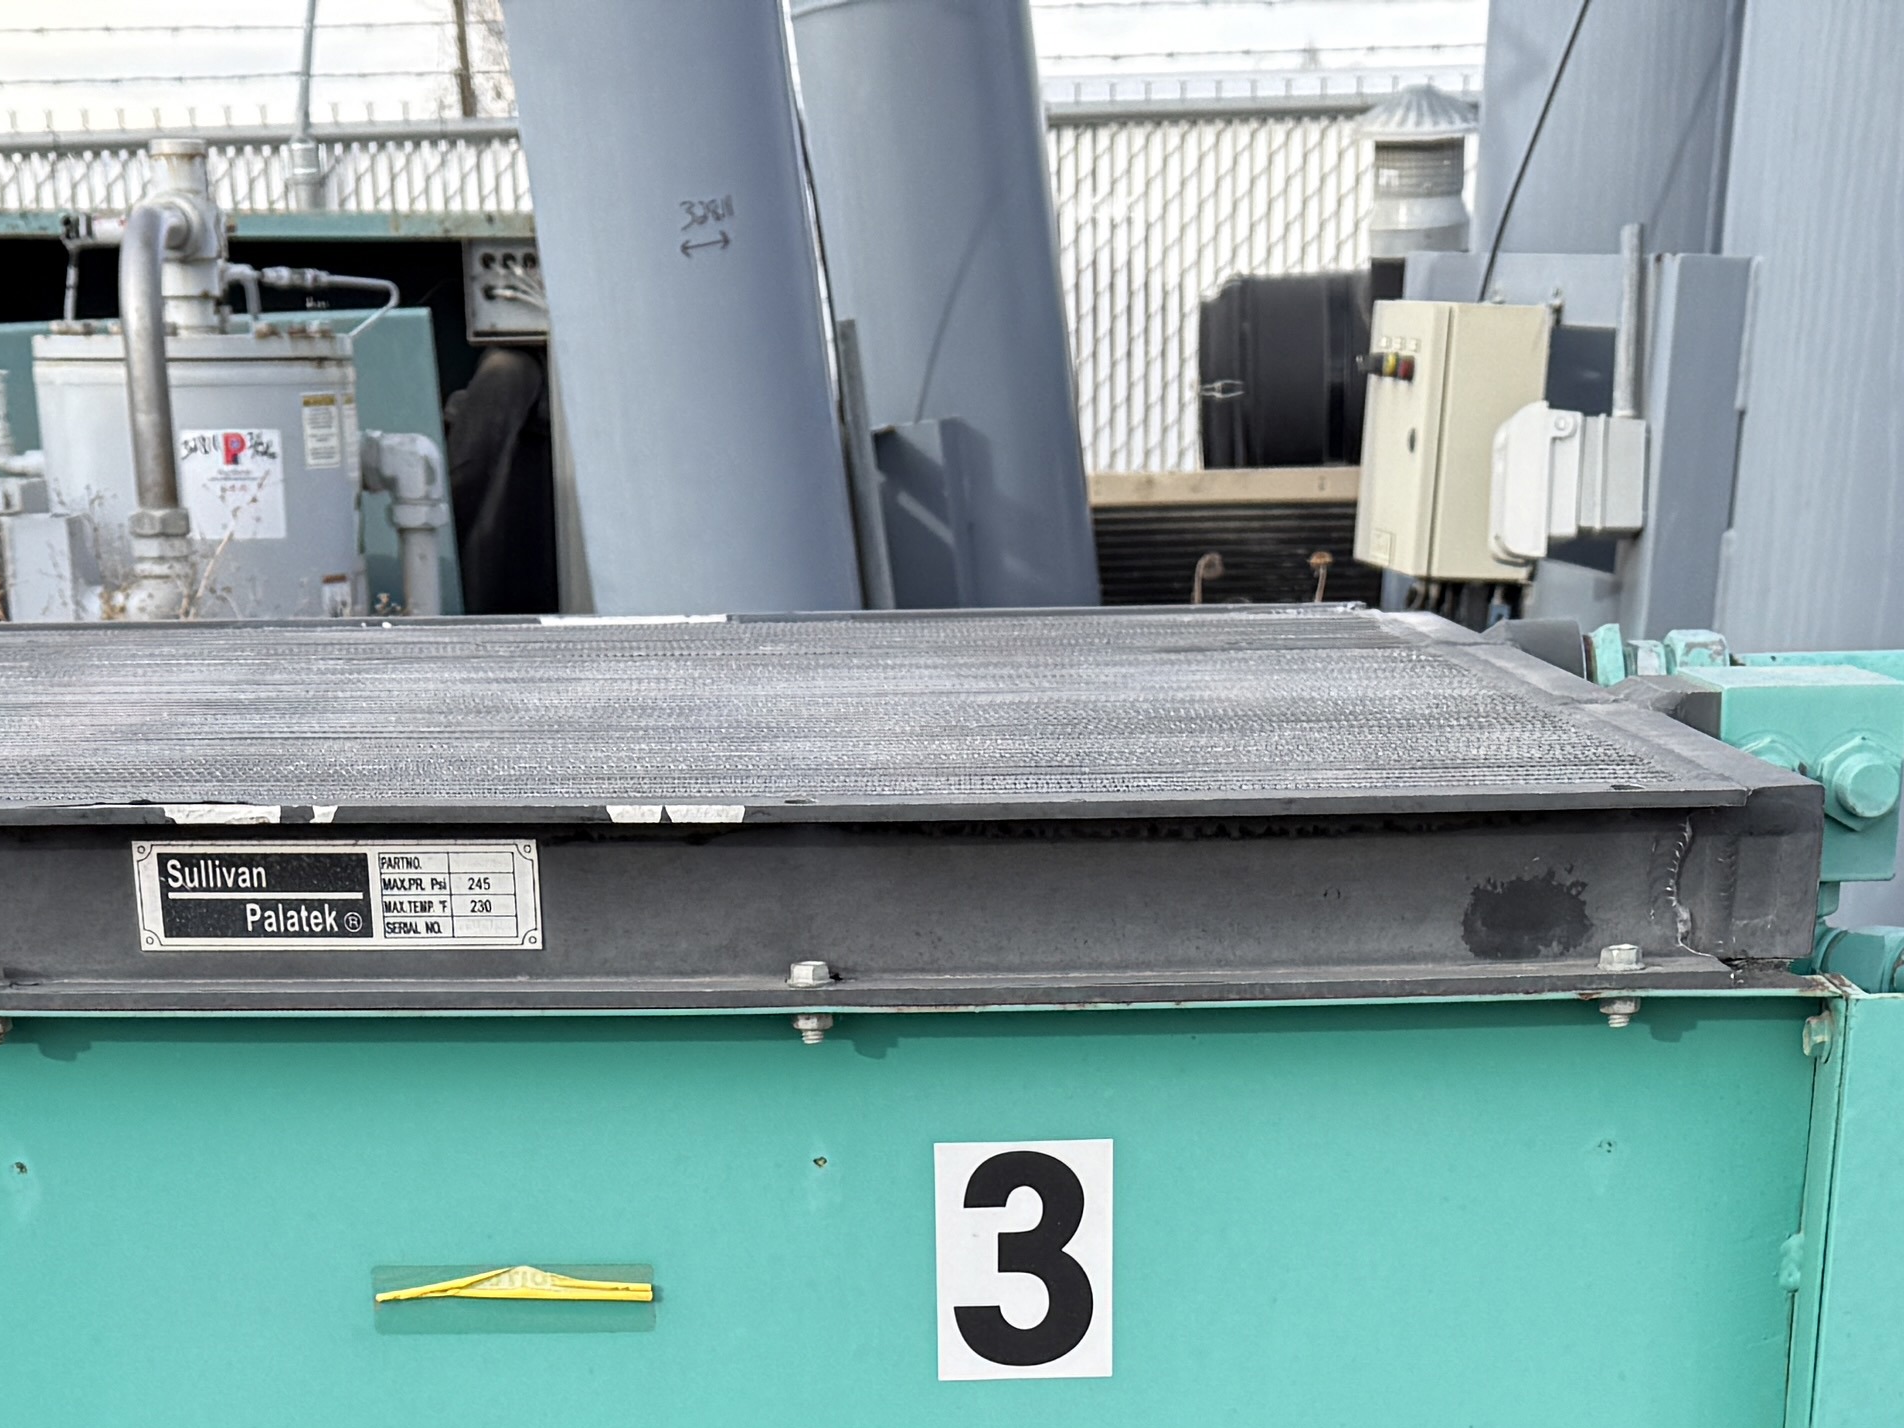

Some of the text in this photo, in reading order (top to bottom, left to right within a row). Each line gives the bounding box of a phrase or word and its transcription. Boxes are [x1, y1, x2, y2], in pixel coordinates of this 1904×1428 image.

[167, 860, 267, 888] Sullivan
[431, 877, 446, 890] Psi
[467, 877, 491, 891] 245
[470, 900, 492, 913] 230
[246, 904, 339, 932] Palatek
[385, 922, 421, 935] SERIAL
[953, 1150, 1094, 1366] 3
